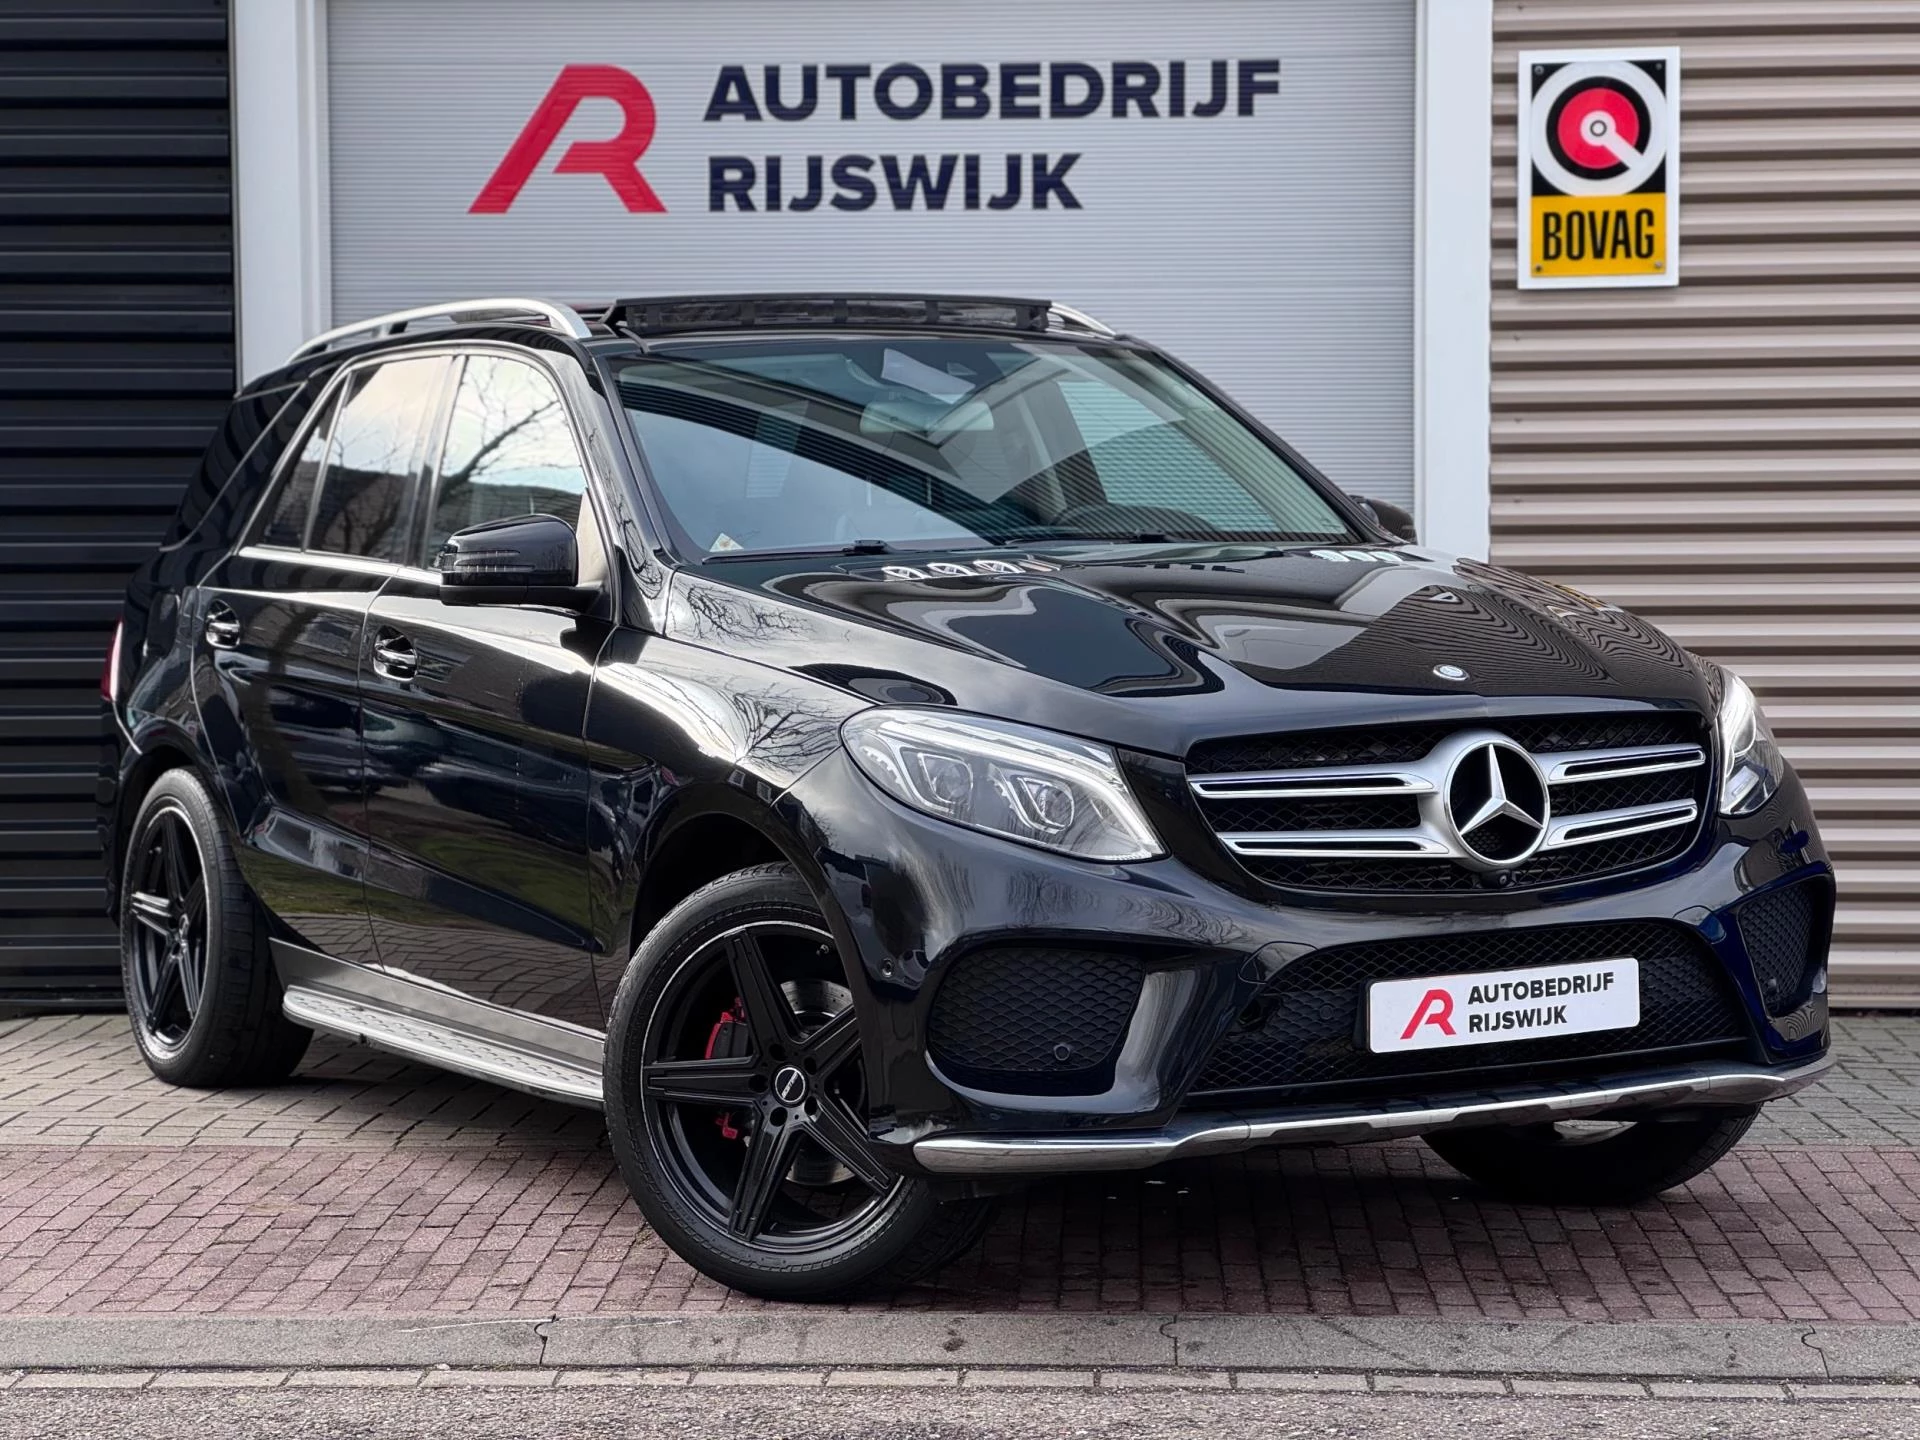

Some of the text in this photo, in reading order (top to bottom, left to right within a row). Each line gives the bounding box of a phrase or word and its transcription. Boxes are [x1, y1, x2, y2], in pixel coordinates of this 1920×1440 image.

[703, 59, 1281, 122] AUTOBEDRIJF
[708, 153, 1083, 213] RIJSWIJK
[1542, 208, 1655, 261] BOVAG
[1467, 971, 1615, 1005] AUTOBEDRIJF
[1468, 1005, 1568, 1033] RIJSWIJK
